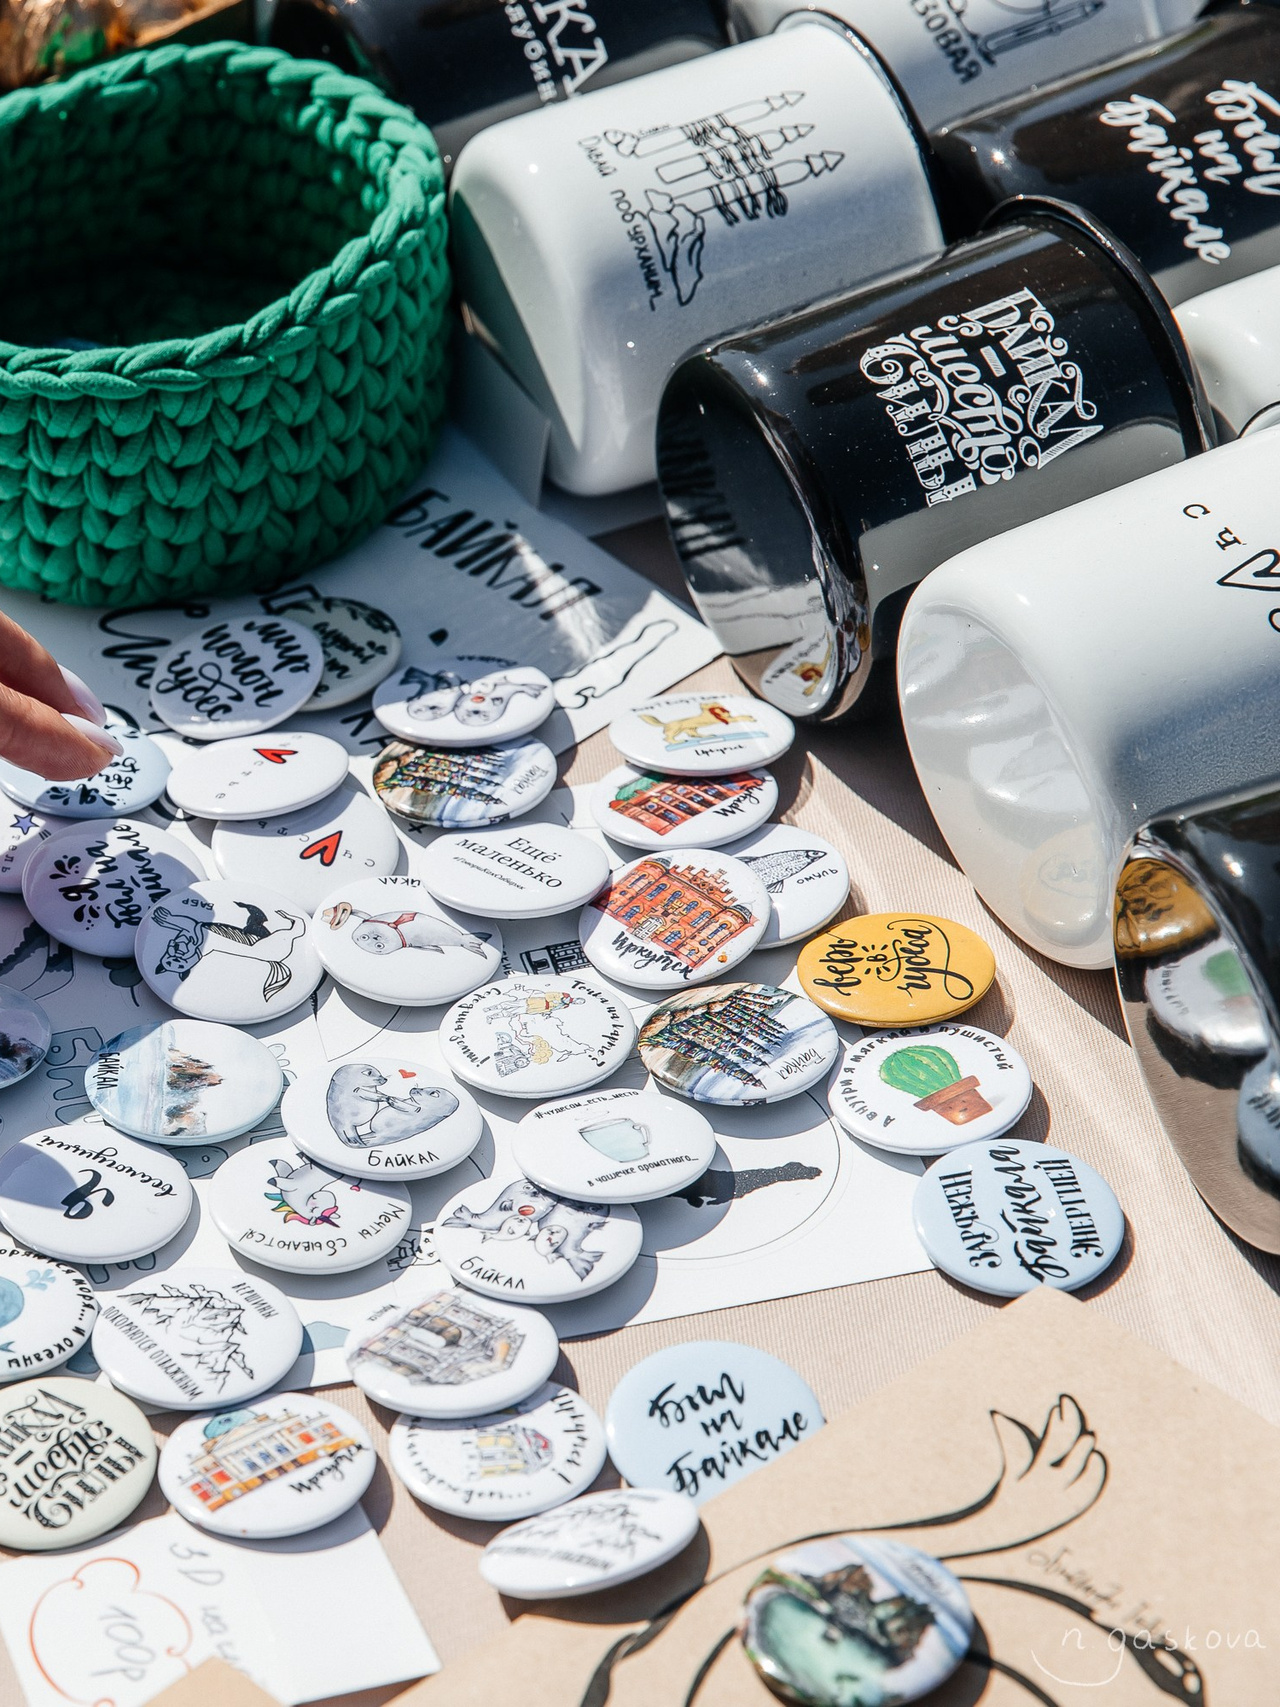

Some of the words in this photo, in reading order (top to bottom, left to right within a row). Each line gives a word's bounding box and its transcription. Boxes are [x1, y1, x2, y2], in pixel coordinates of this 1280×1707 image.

[905, 0, 983, 84] ЗОВАЯ
[1099, 94, 1231, 265] Байкале
[112, 823, 172, 904] айкале
[453, 837, 564, 890] маленько
[503, 836, 563, 865] Ещё
[609, 930, 695, 981] Иркутск
[813, 931, 860, 997] верь
[367, 1150, 441, 1168] БАЙКАЛ
[459, 1256, 526, 1290] БАЙКАЛ
[648, 1373, 746, 1428] Был
[699, 1408, 746, 1438] на
[665, 1411, 809, 1497] Байкале
